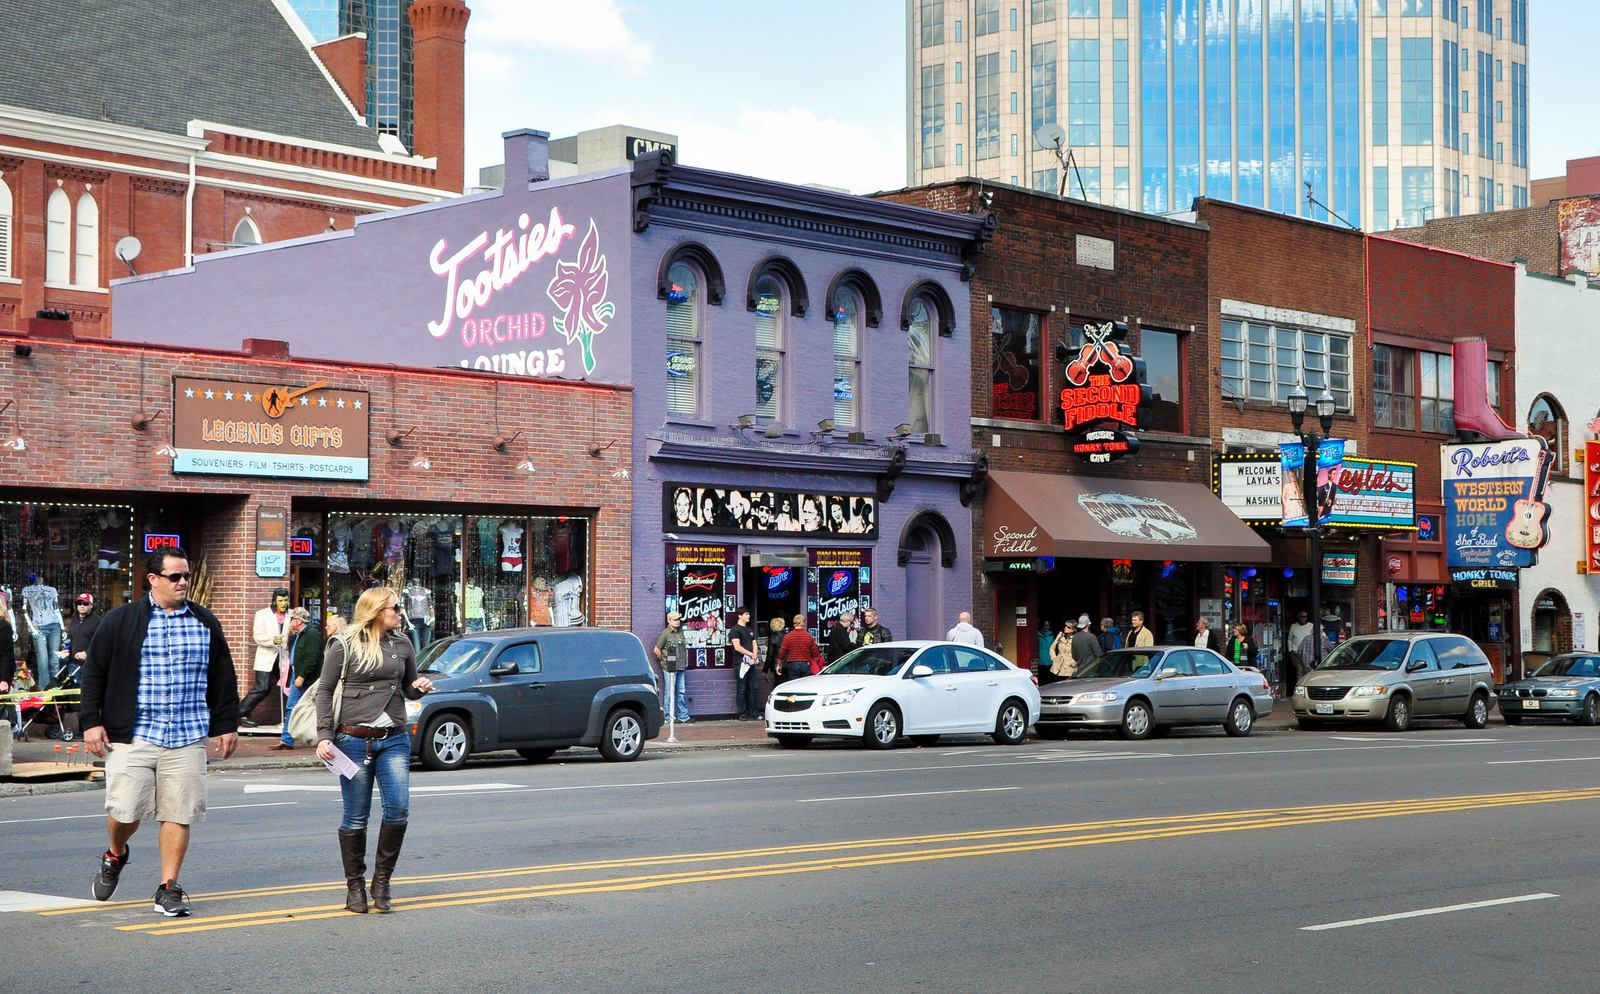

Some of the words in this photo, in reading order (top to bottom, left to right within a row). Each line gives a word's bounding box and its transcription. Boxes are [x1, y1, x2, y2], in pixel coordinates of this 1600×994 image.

[427, 206, 576, 338] Tootsies
[461, 311, 547, 347] ORCHID
[1088, 374, 1111, 387] THE
[1061, 384, 1141, 410] SECOND
[1064, 403, 1137, 430] FIDDLE
[202, 419, 284, 445] LEGENDS
[290, 424, 343, 449] GIFTS
[1073, 443, 1102, 452] HONKY
[191, 457, 244, 469] SOUVENIERS
[249, 461, 268, 470] FILM
[272, 462, 305, 471] TSHIRTS
[309, 464, 354, 474] POSTCARDS
[1451, 446, 1530, 477] Robert's
[1237, 466, 1277, 475] WELCOME
[1246, 476, 1280, 485] LAYLA'S
[1337, 463, 1409, 496] ayla's
[1454, 481, 1524, 497] WESTERN
[1455, 497, 1508, 512] WORLD
[1456, 512, 1498, 527] HOME
[993, 525, 1038, 543] Second
[1455, 533, 1498, 546] Sho-Bud
[1471, 526, 1479, 538] of
[147, 536, 177, 550] OPEN
[290, 540, 310, 553] EN
[993, 539, 1039, 554] Fiddle
[1009, 562, 1032, 571] ATM
[1452, 570, 1488, 581] HONKY
[1488, 570, 1518, 581] TONK
[679, 596, 723, 621] Tootsies
[820, 597, 858, 620] Tootsies
